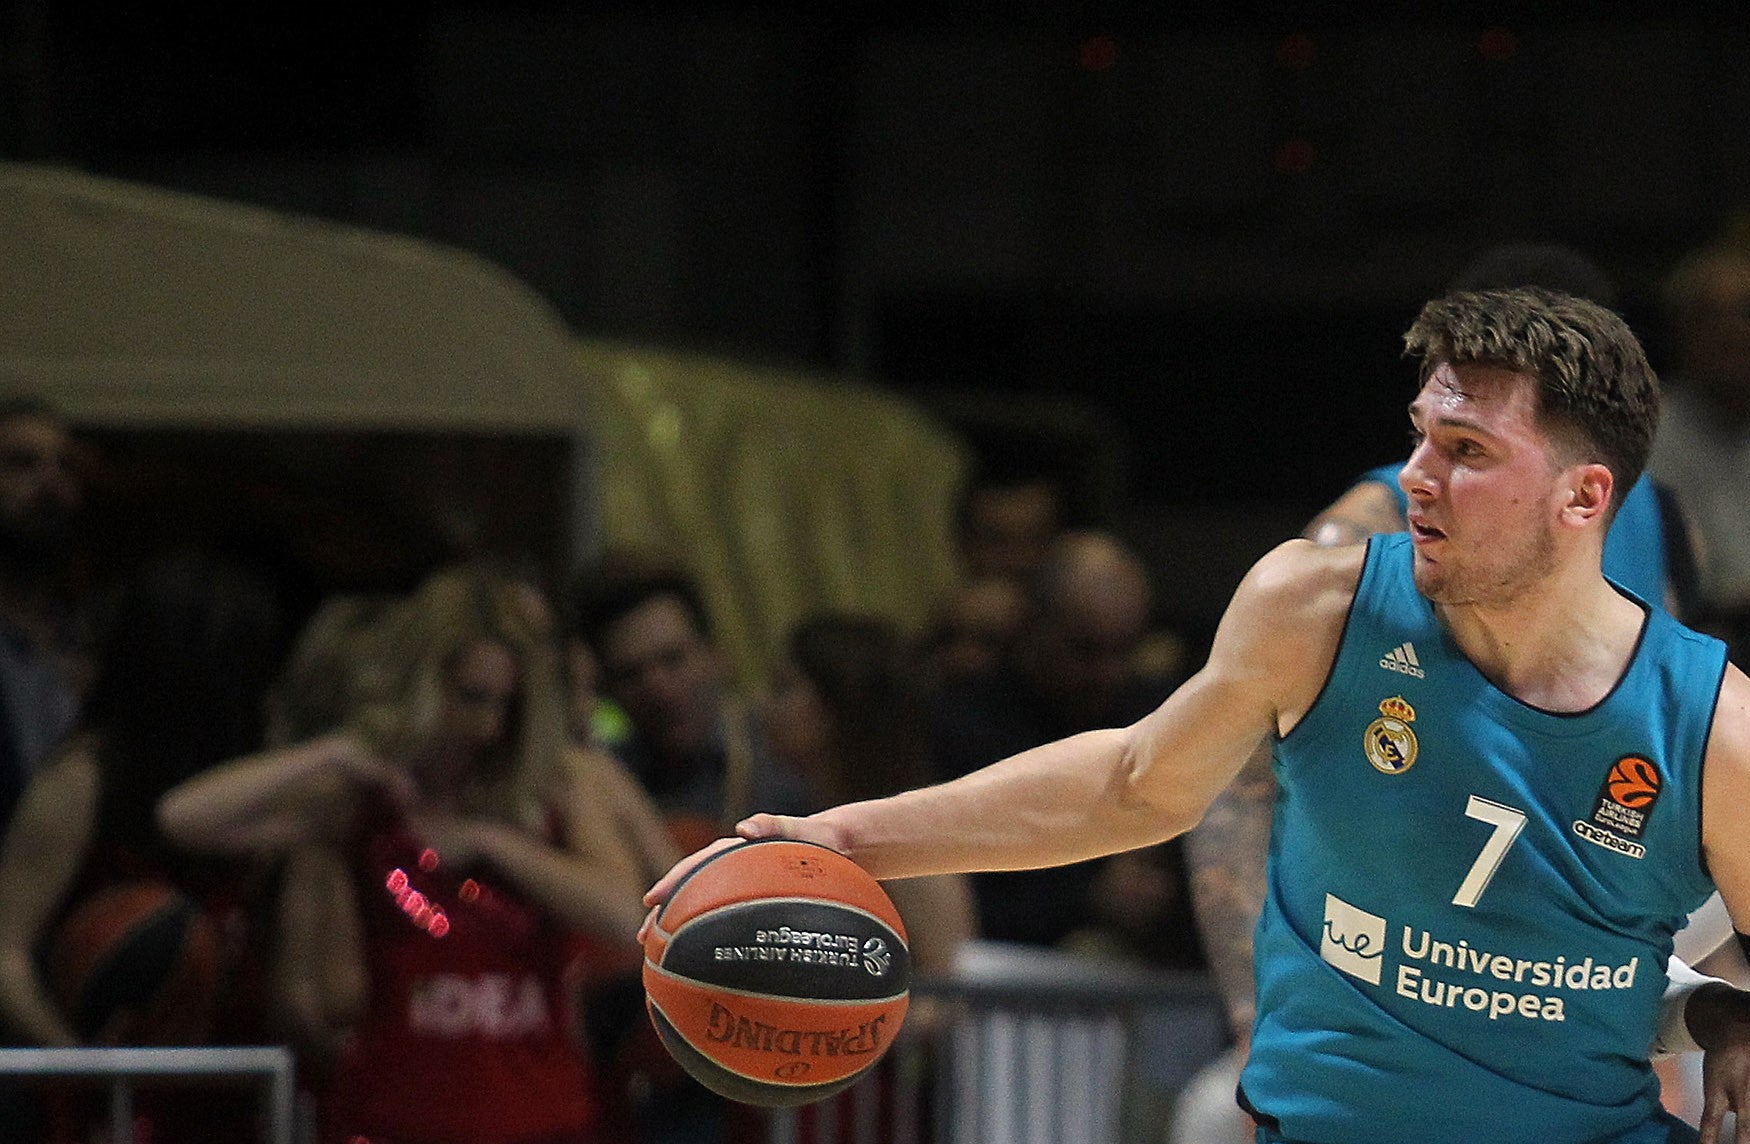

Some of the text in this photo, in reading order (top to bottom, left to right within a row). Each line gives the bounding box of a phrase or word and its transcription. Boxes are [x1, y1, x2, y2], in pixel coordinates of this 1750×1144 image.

[1379, 659, 1425, 679] adidas
[1597, 806, 1642, 829] AIRLINES
[1601, 798, 1645, 821] TURKISH
[1451, 793, 1530, 908] 7
[1574, 822, 1645, 857] oneteam
[713, 947, 860, 968] TURKISH AIRLINES
[1401, 925, 1639, 991] Universidad
[1395, 964, 1566, 1022] Europea
[706, 1002, 887, 1057] SPALDING
